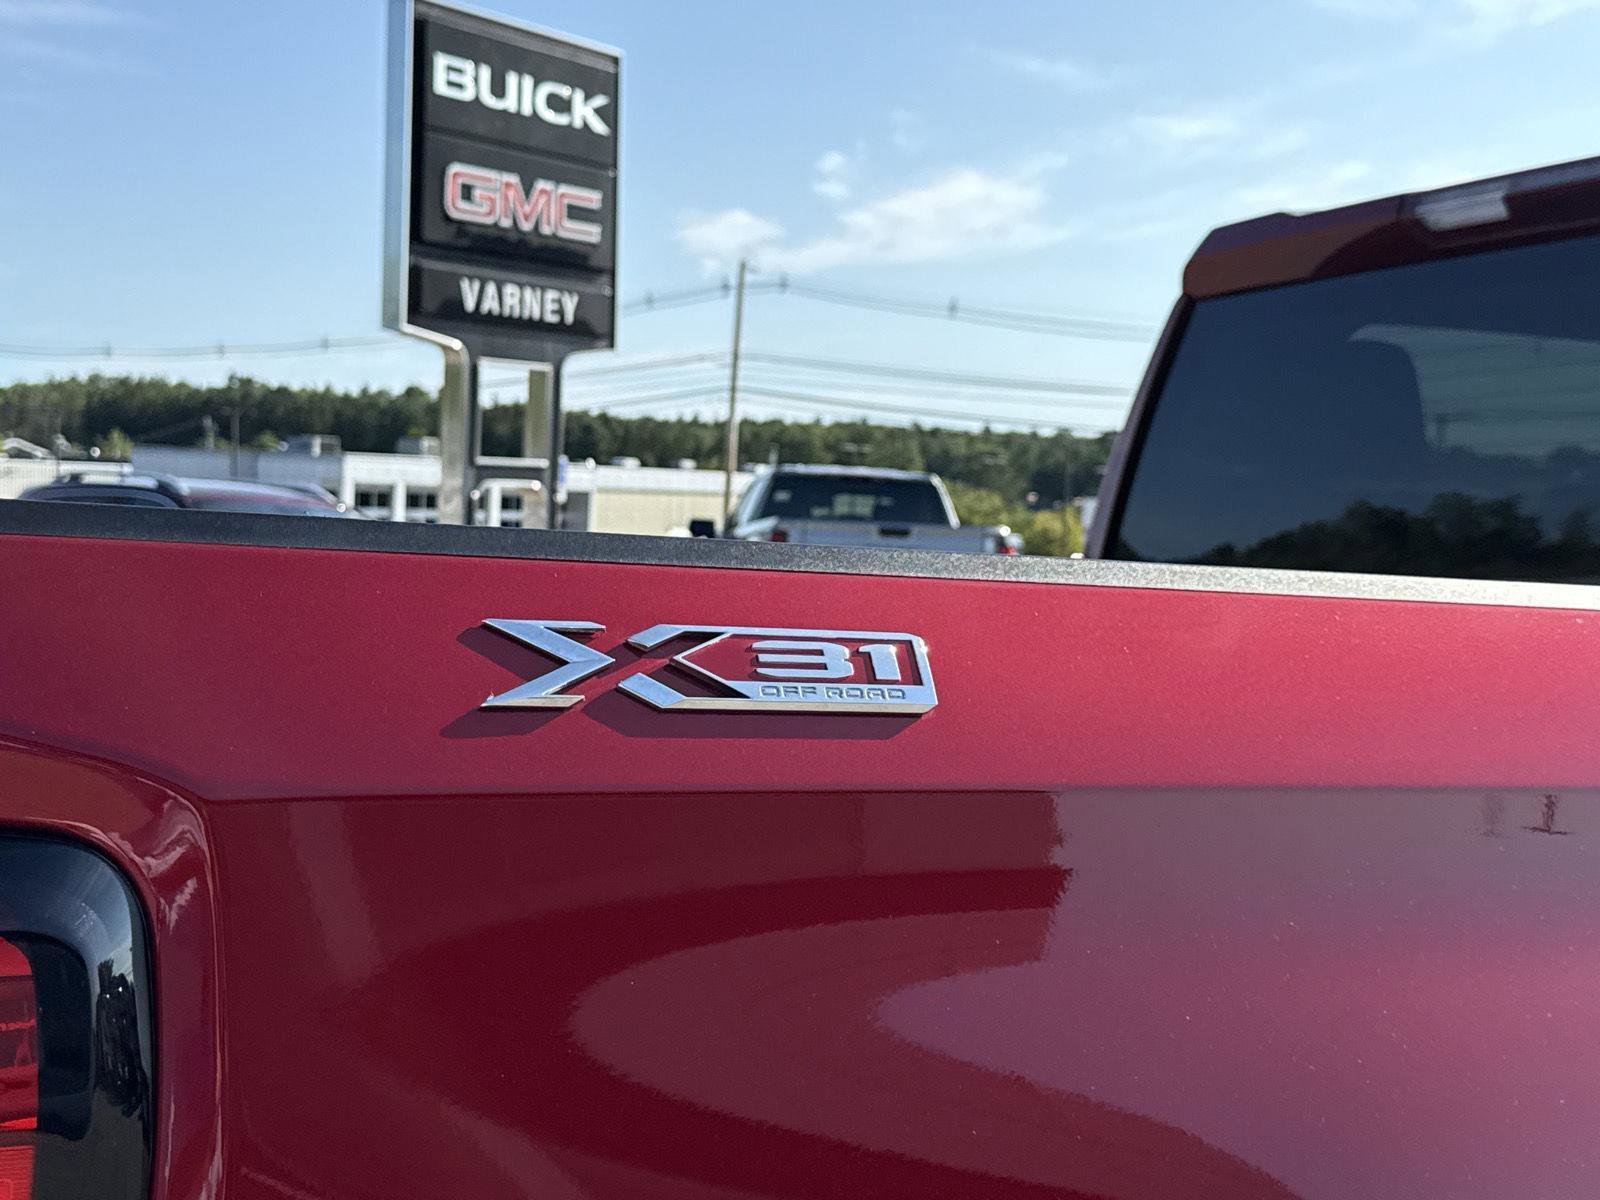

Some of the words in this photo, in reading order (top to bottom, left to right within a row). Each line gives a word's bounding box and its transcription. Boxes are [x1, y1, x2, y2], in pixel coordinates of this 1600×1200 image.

[432, 52, 610, 136] BUICK
[444, 162, 603, 243] GMC
[459, 276, 580, 326] VARNEY
[760, 685, 817, 698] OFF
[824, 686, 906, 700] ROAD
